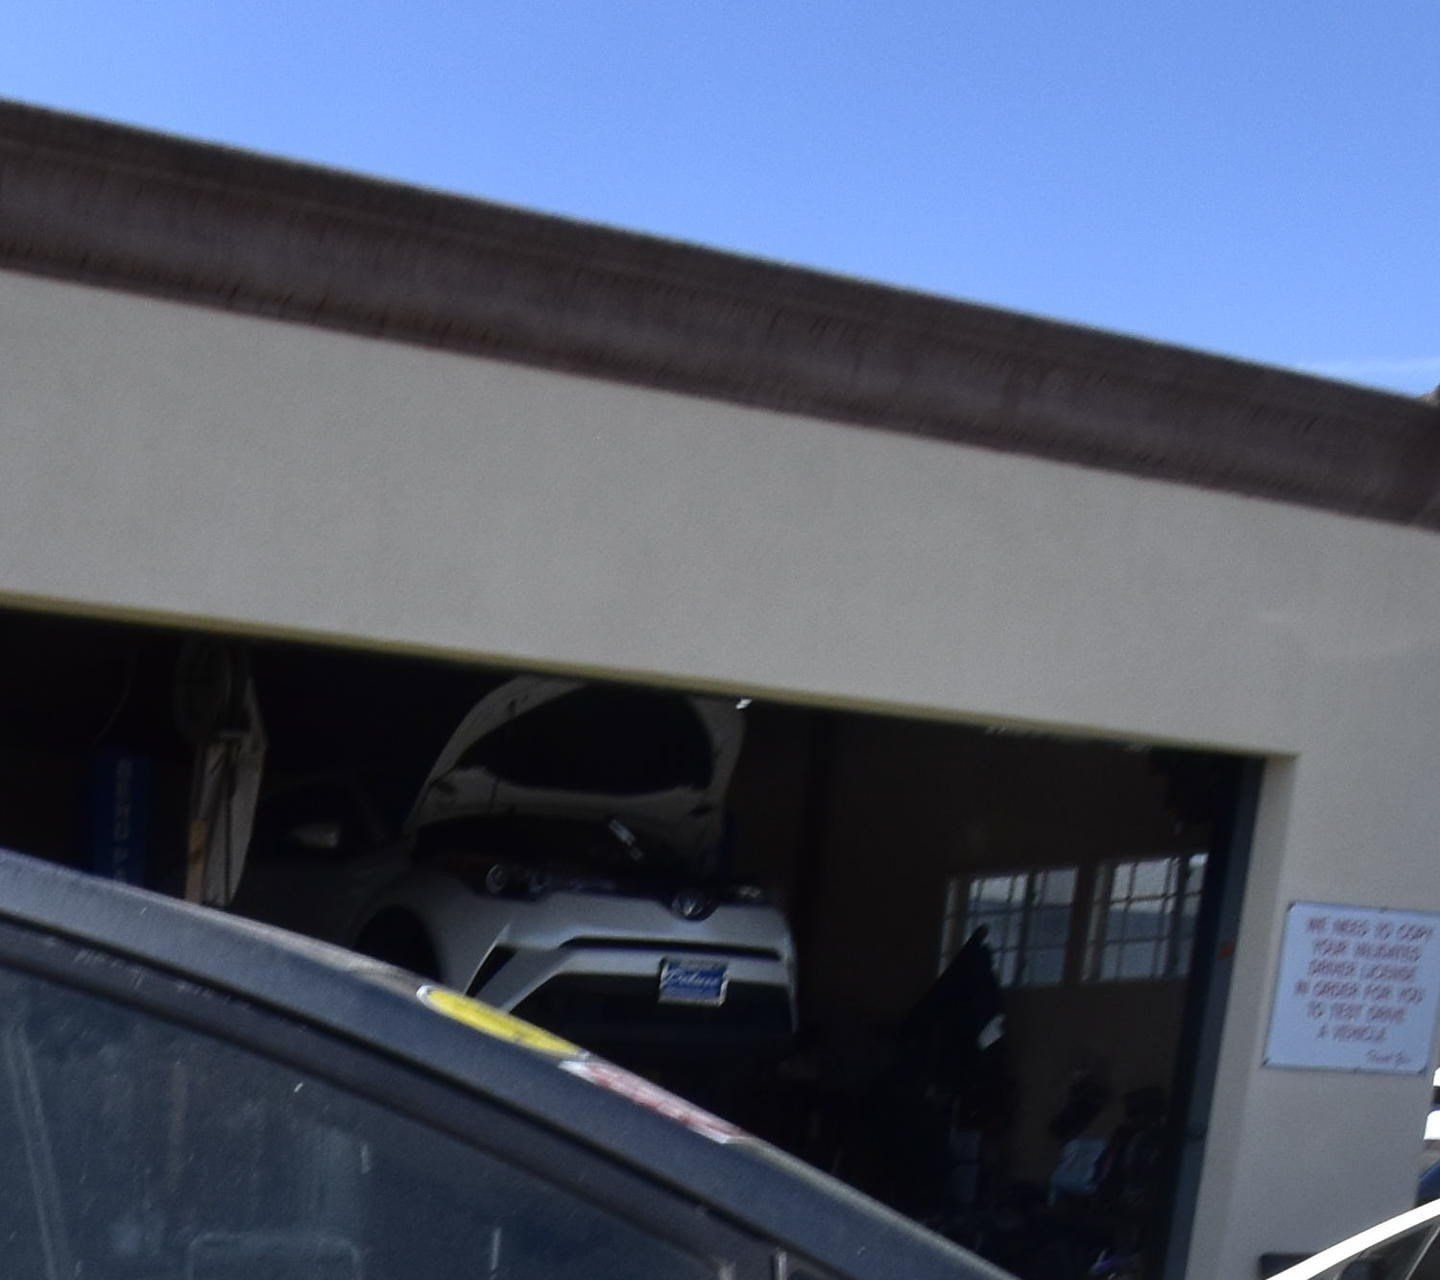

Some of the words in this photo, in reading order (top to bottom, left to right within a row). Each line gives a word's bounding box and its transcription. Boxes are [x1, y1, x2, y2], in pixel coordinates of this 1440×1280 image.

[1333, 918, 1369, 937] NEED
[1376, 921, 1395, 940] TO
[1397, 922, 1433, 943] COPY
[1314, 938, 1349, 956] YOUR
[1313, 981, 1359, 998] ORDER
[1364, 984, 1393, 1001] FOR
[1399, 986, 1425, 1004] YOU
[1330, 1002, 1363, 1020] TEST
